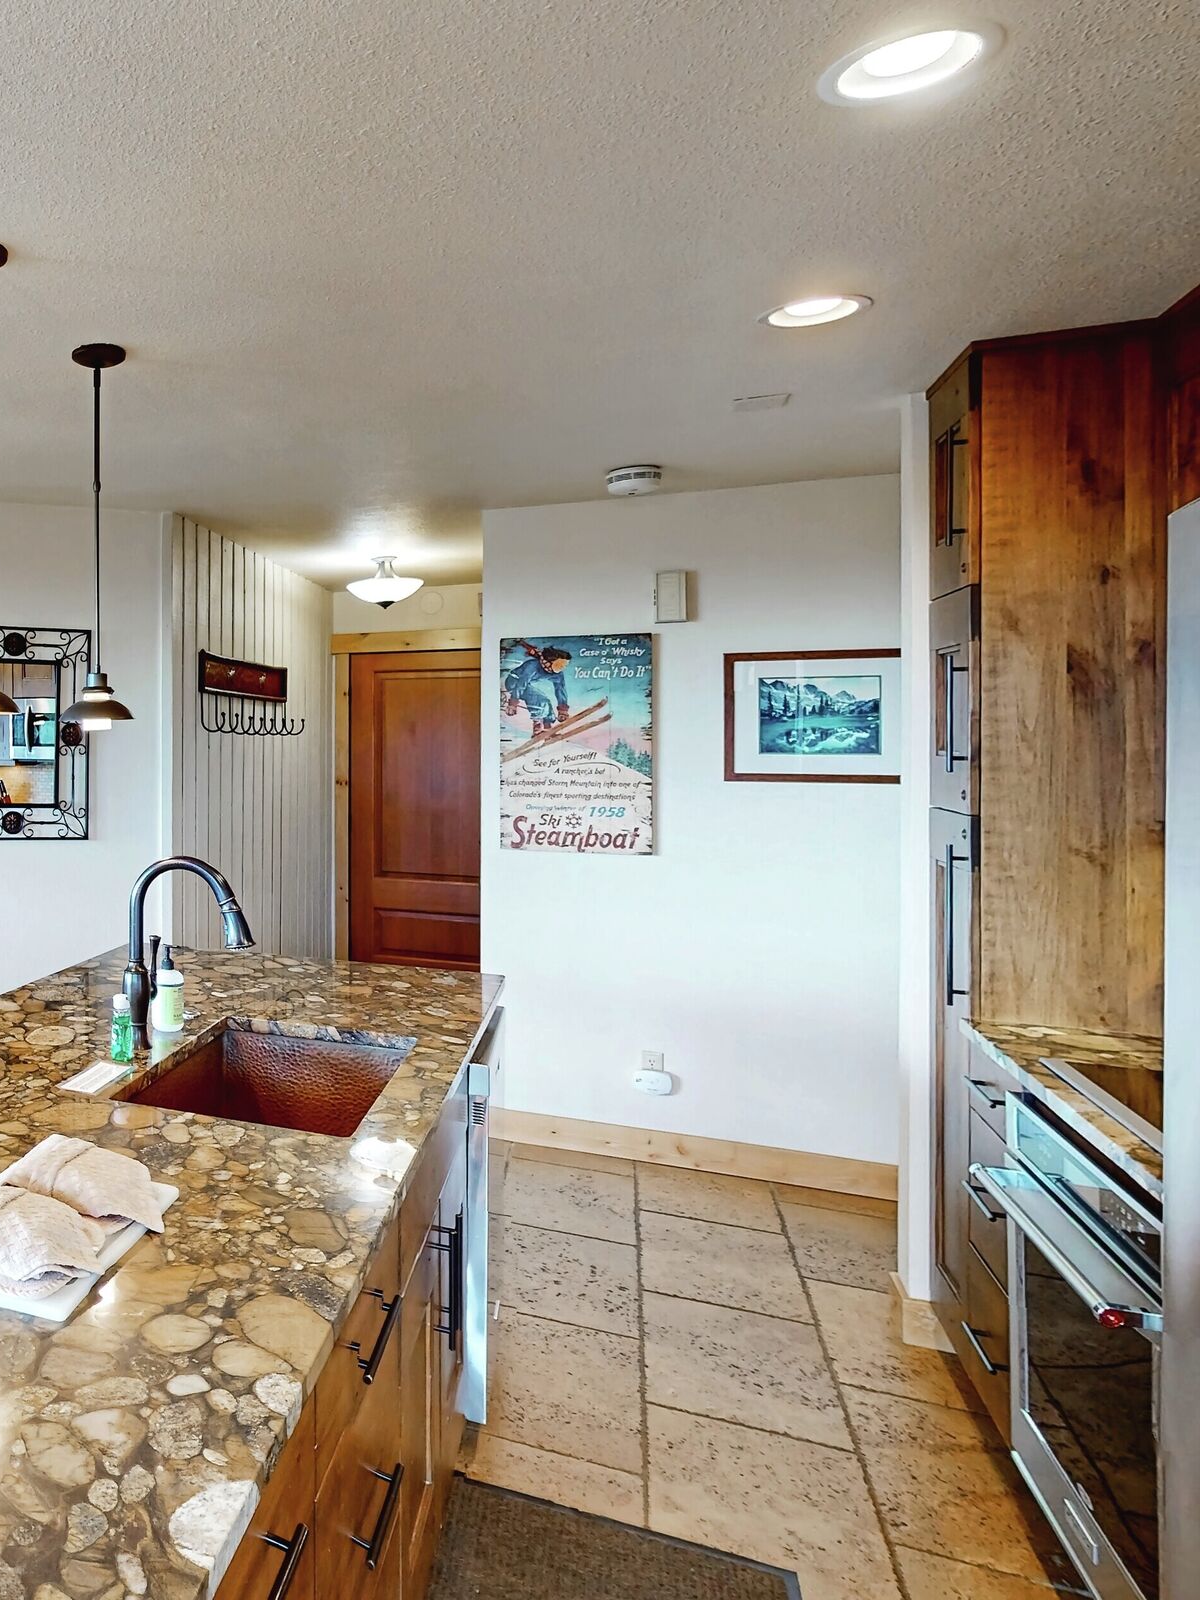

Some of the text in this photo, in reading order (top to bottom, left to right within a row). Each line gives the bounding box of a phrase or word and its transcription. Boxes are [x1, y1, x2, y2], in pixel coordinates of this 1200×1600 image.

[580, 648, 600, 657] Case
[611, 646, 646, 657] Whisky
[574, 667, 591, 679] You
[592, 666, 619, 681] Can't
[620, 665, 634, 678] Do
[532, 751, 598, 768] See for Yourself!
[547, 779, 568, 788] Storm
[570, 780, 602, 788] Mountain
[589, 806, 626, 818] 1958
[538, 813, 562, 829] Ski
[510, 815, 640, 853] Steamboat
